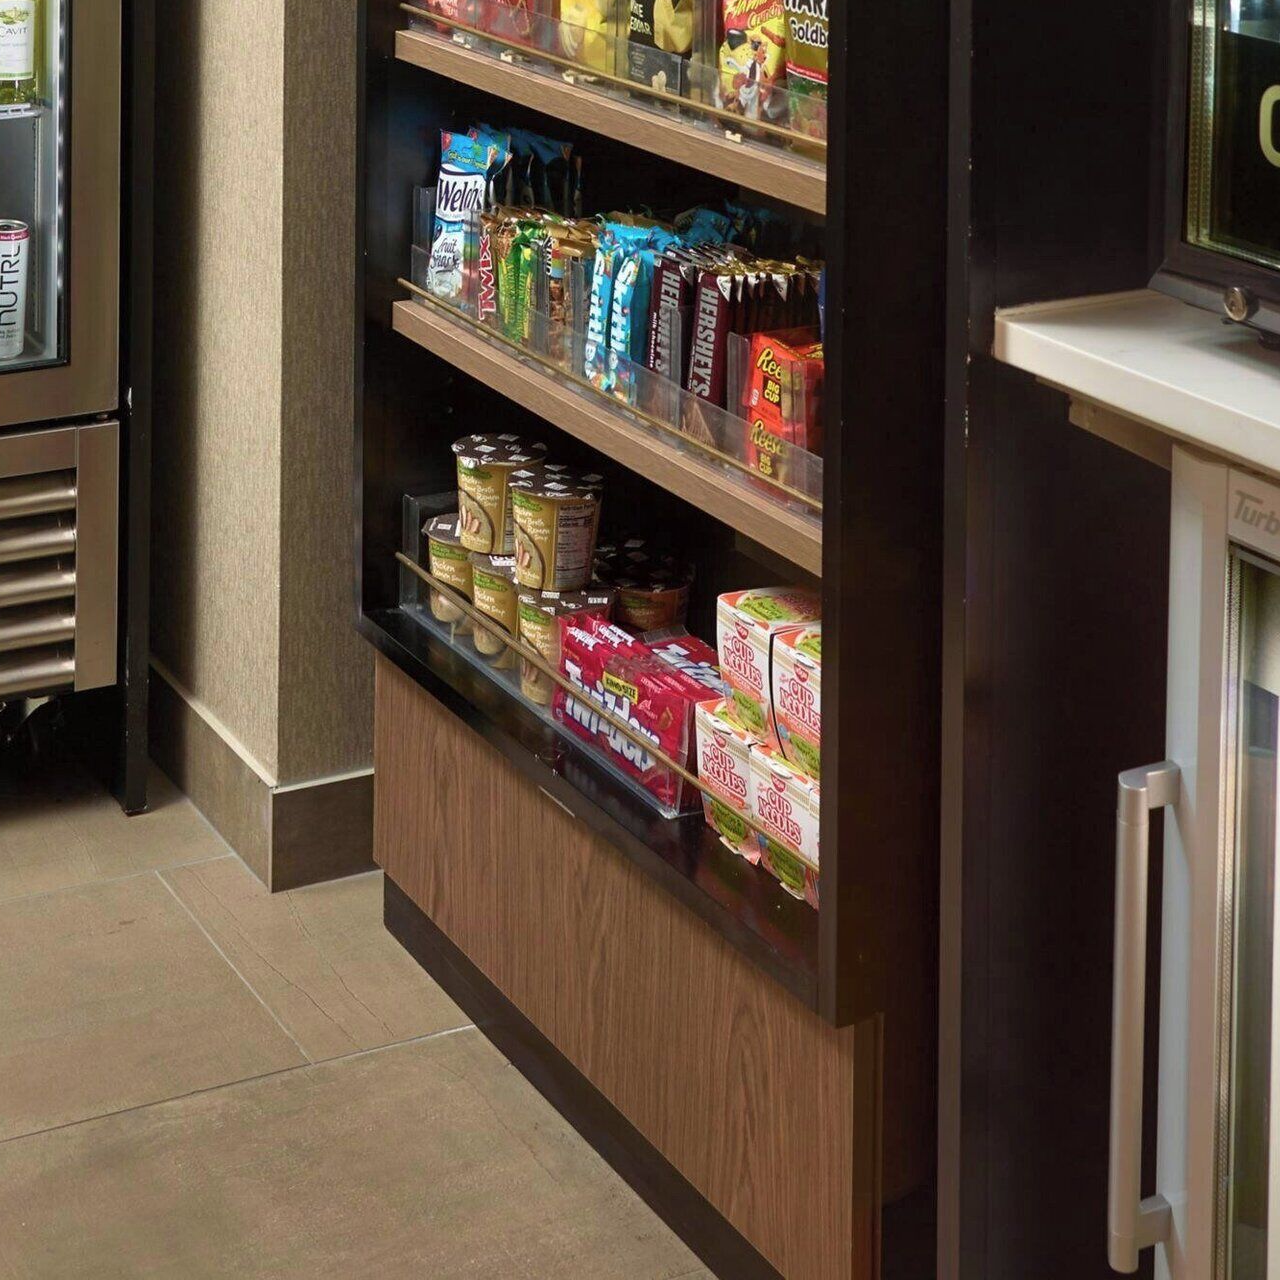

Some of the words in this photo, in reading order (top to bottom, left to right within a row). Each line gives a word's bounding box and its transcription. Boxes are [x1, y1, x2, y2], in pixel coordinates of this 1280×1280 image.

[437, 178, 484, 213] Welch's
[478, 236, 496, 321] TWIX
[691, 286, 719, 397] HERSHEY'S
[764, 391, 780, 404] CUP
[767, 380, 780, 393] BIG
[732, 636, 754, 662] CUP
[724, 646, 763, 690] NOODLES
[780, 687, 820, 732] NOODLES
[789, 679, 814, 706] CUP
[703, 752, 747, 798] NOODLES
[710, 744, 735, 771] CUP
[767, 787, 792, 814] CUP
[758, 796, 801, 846] NOODLES
